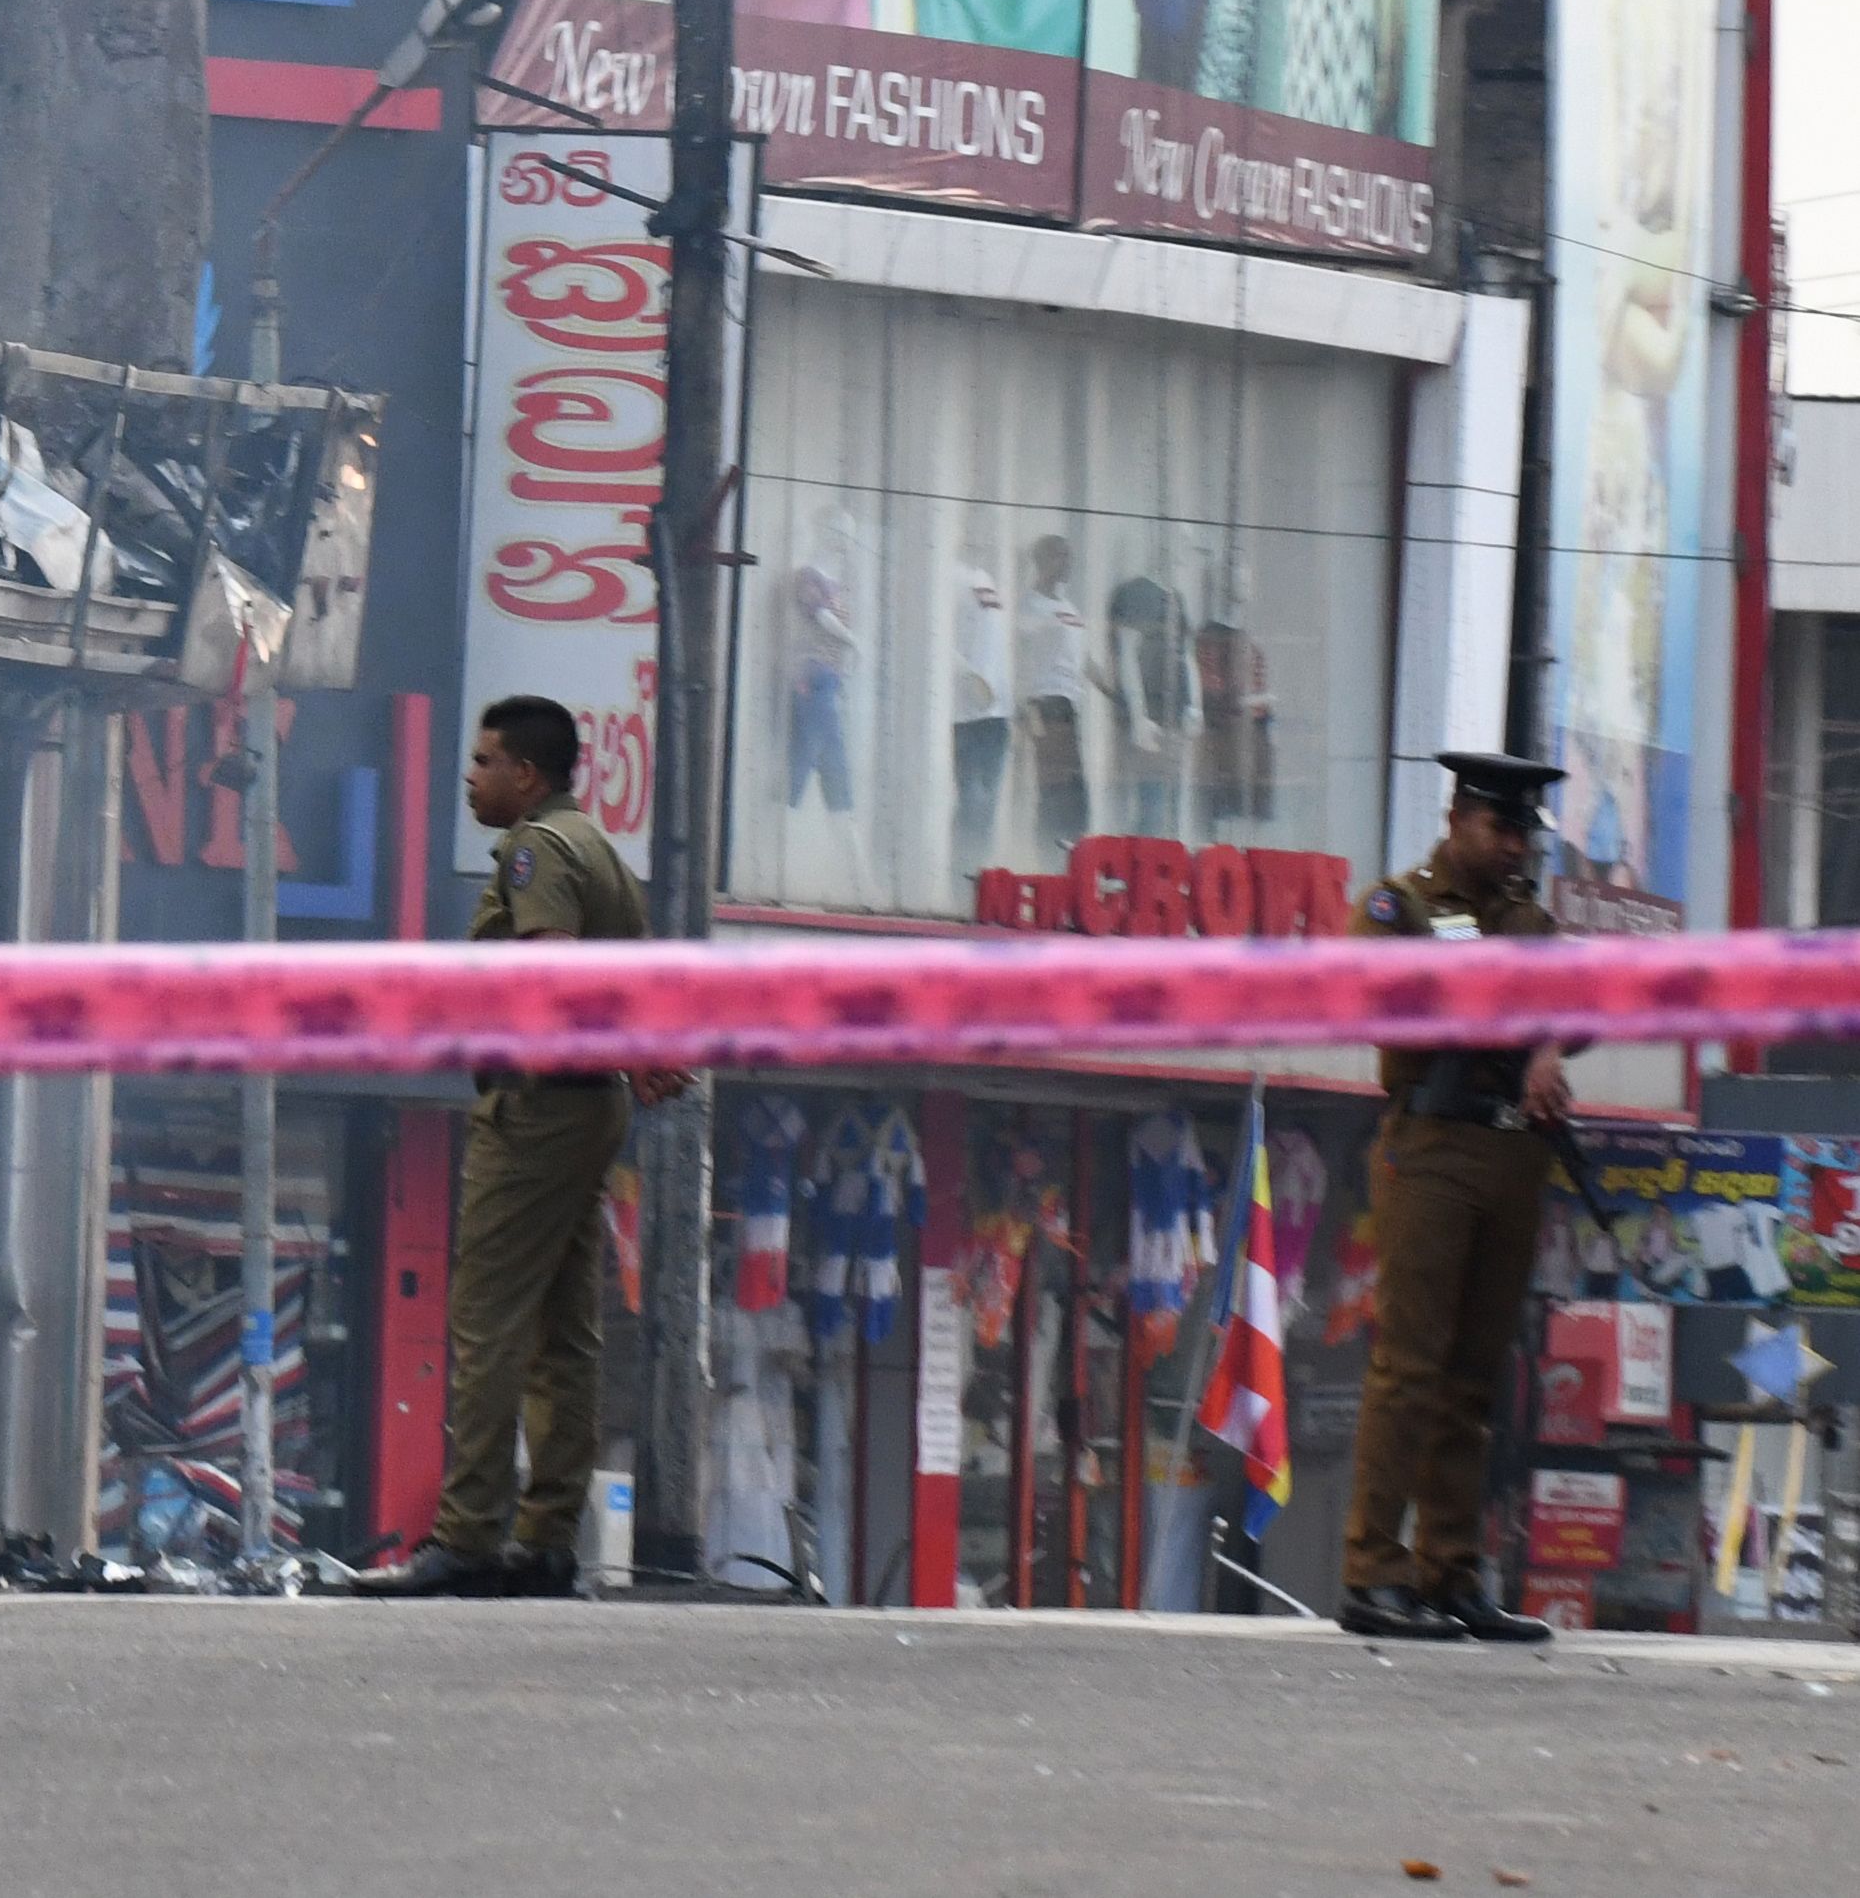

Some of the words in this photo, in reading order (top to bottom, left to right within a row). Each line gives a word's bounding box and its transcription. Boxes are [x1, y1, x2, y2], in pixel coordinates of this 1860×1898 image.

[544, 21, 657, 116] New
[826, 64, 1045, 165] FASHIONS
[1114, 106, 1194, 203] New
[1291, 156, 1435, 255] FASHIONS
[1068, 834, 1353, 936] CROWN
